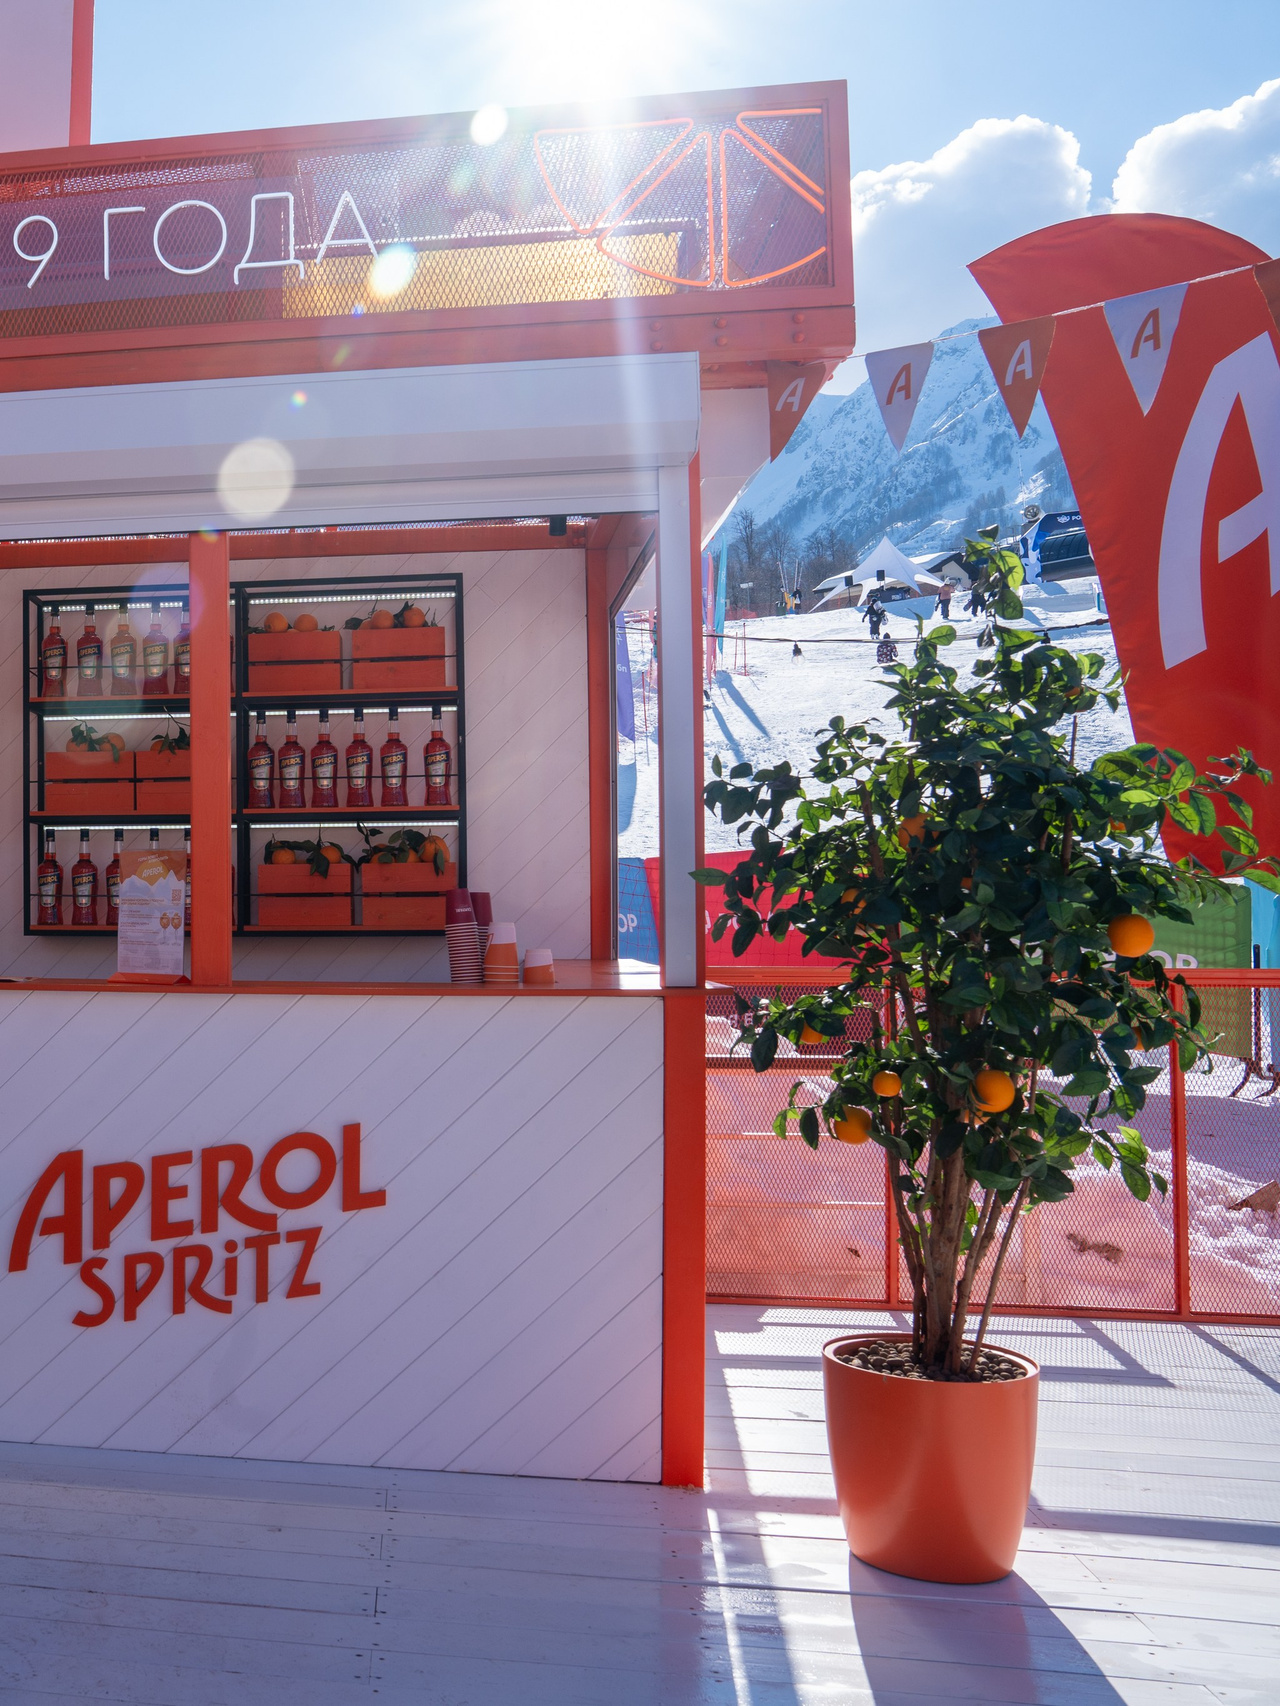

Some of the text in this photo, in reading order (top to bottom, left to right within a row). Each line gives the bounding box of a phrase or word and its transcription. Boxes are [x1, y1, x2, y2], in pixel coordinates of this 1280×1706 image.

[103, 191, 378, 286] ГОДА
[1130, 307, 1161, 359] A
[886, 362, 912, 406] A
[1005, 339, 1033, 386] A
[775, 377, 806, 412] A
[141, 865, 164, 878] APEROL
[8, 1122, 387, 1273] APEROL
